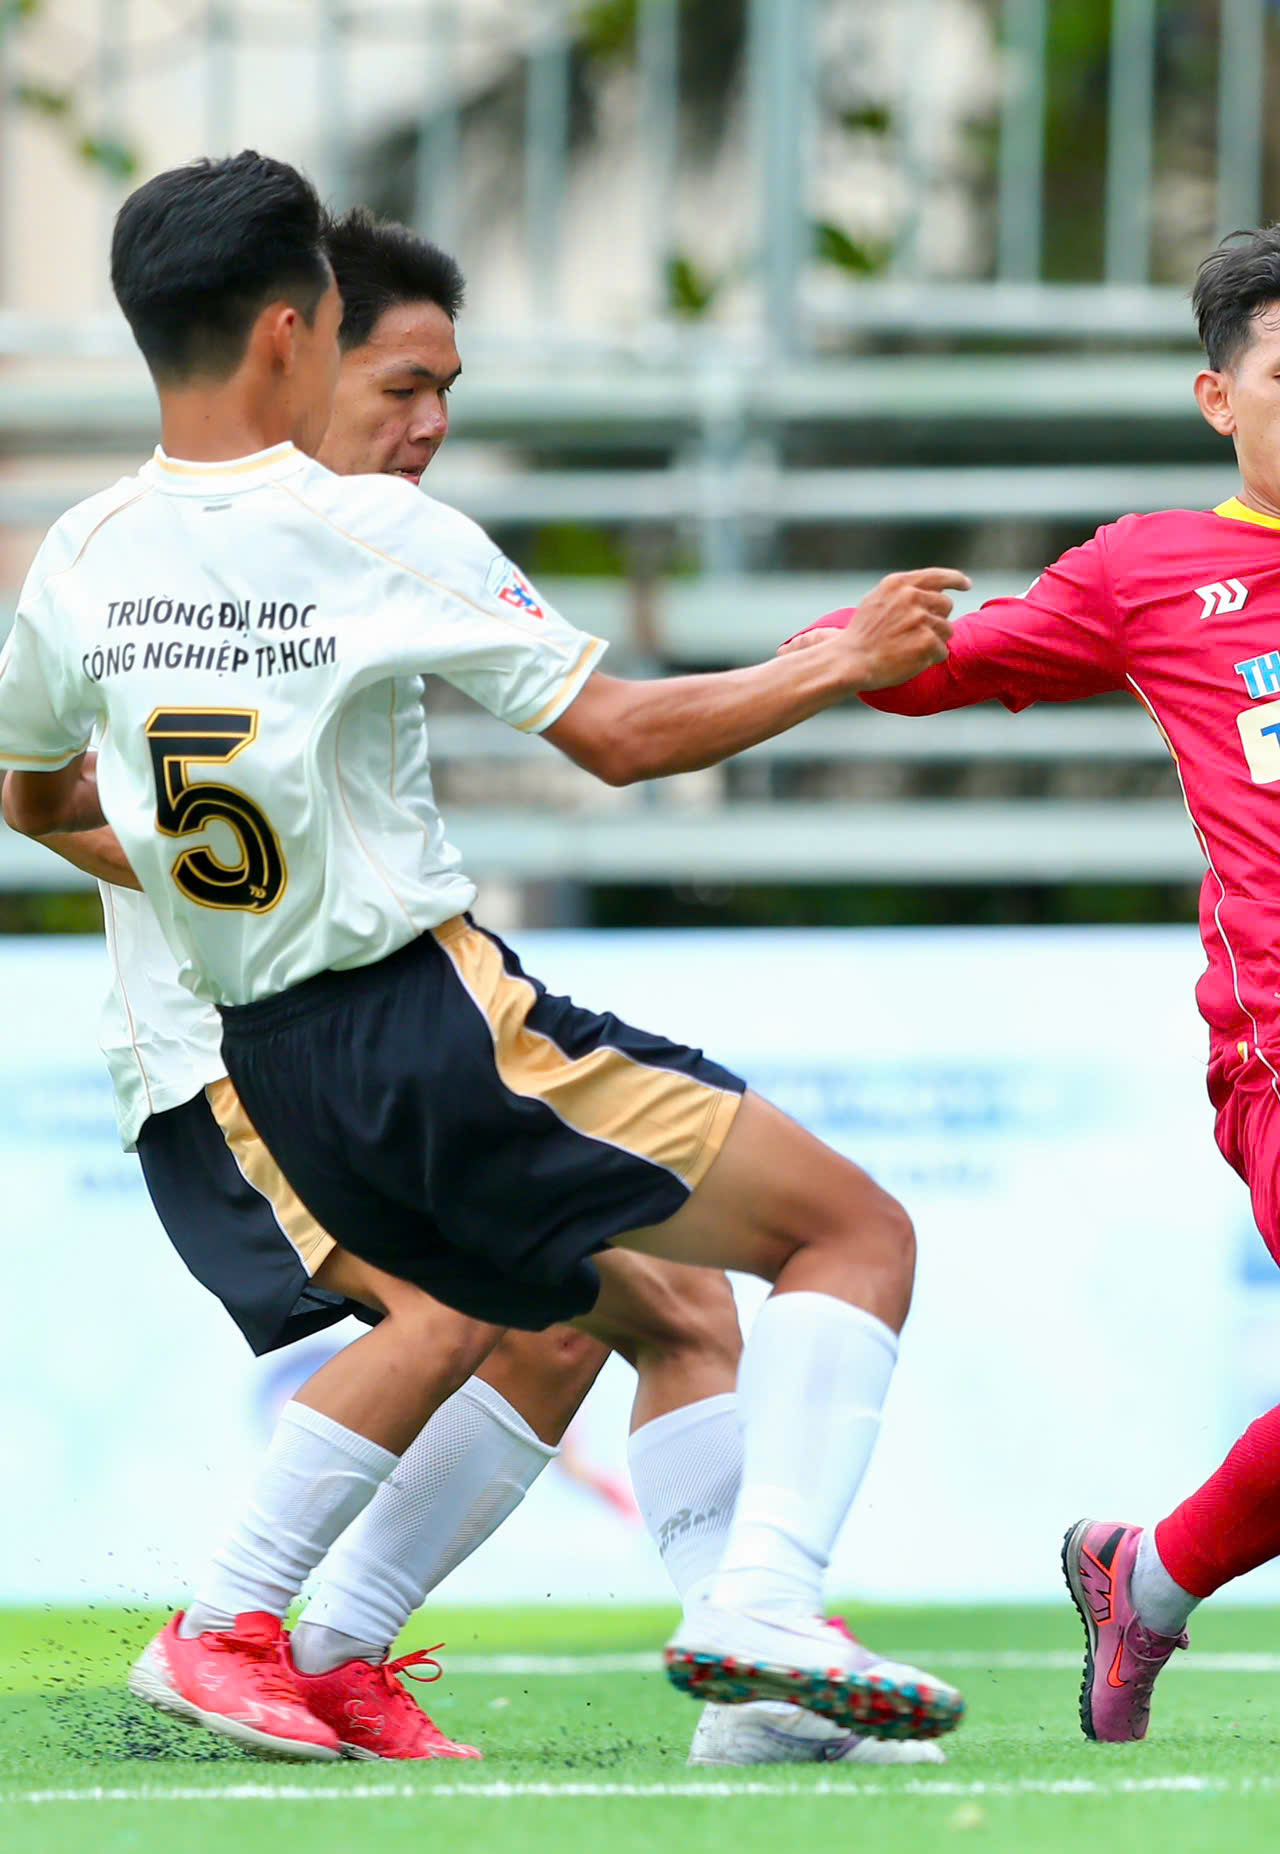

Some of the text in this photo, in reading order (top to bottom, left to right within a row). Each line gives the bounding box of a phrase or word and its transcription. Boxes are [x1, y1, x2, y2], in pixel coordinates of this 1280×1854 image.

[107, 594, 213, 630] TRƯỜNG
[82, 636, 336, 683] CÔNG NGHIỆP TP.HCM
[145, 706, 287, 914] 5
